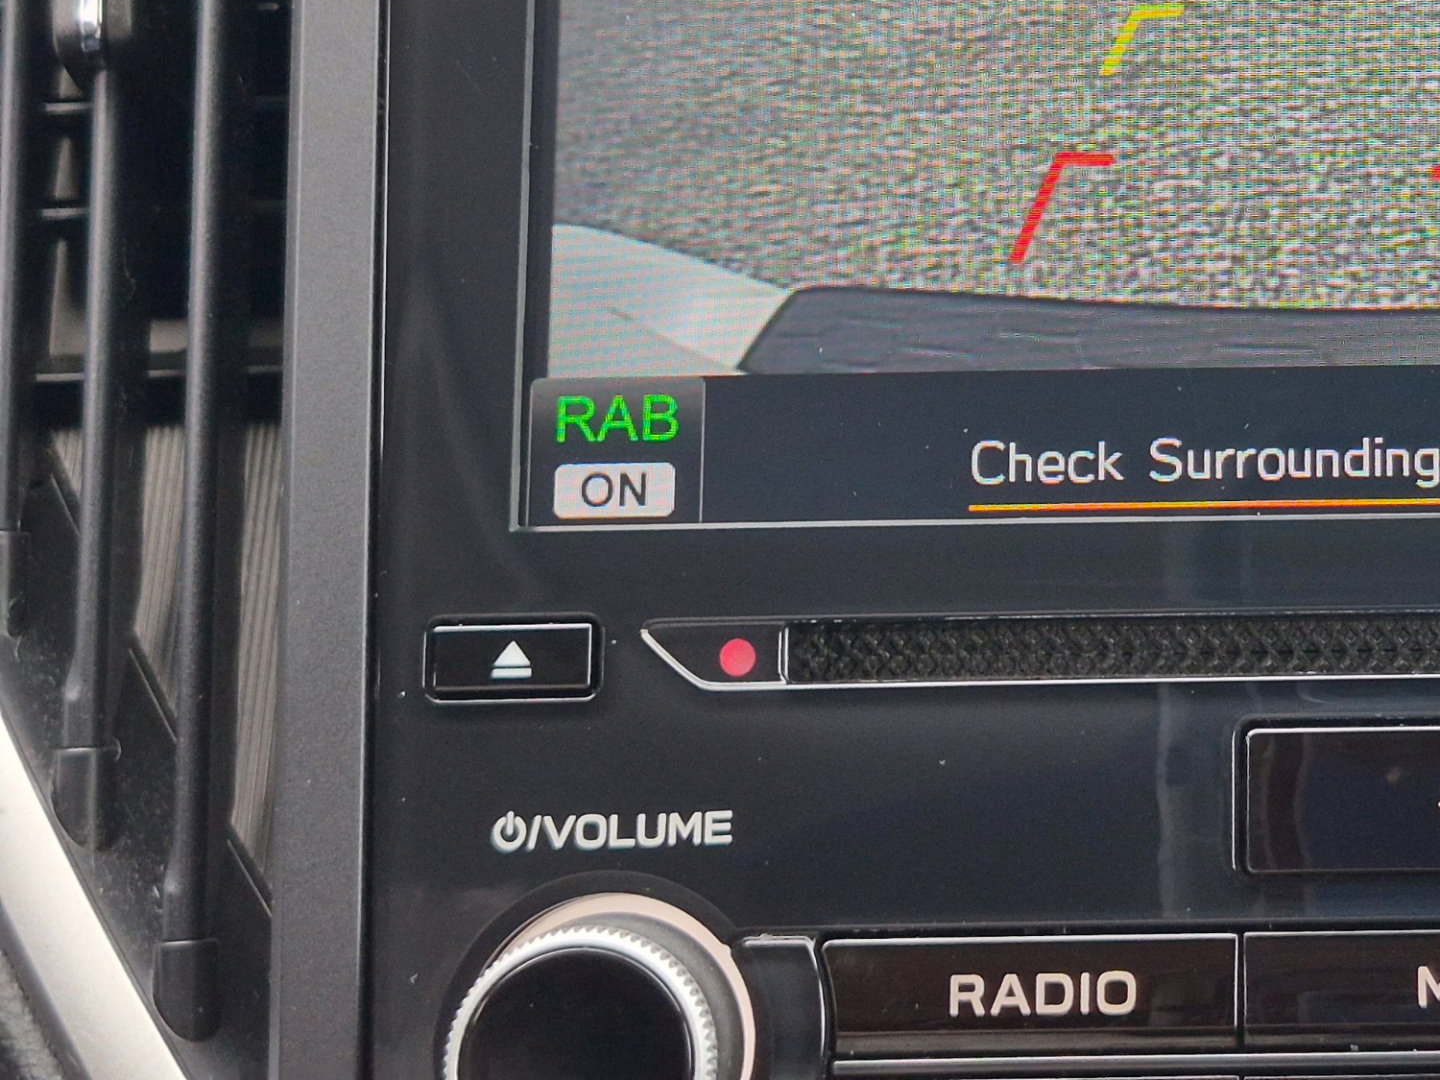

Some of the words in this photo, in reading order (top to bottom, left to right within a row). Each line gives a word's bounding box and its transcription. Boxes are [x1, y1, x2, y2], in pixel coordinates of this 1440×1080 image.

[555, 394, 680, 443] RAB
[970, 439, 1125, 486] Check
[580, 472, 648, 508] ON
[948, 969, 1138, 1017] RADIO
